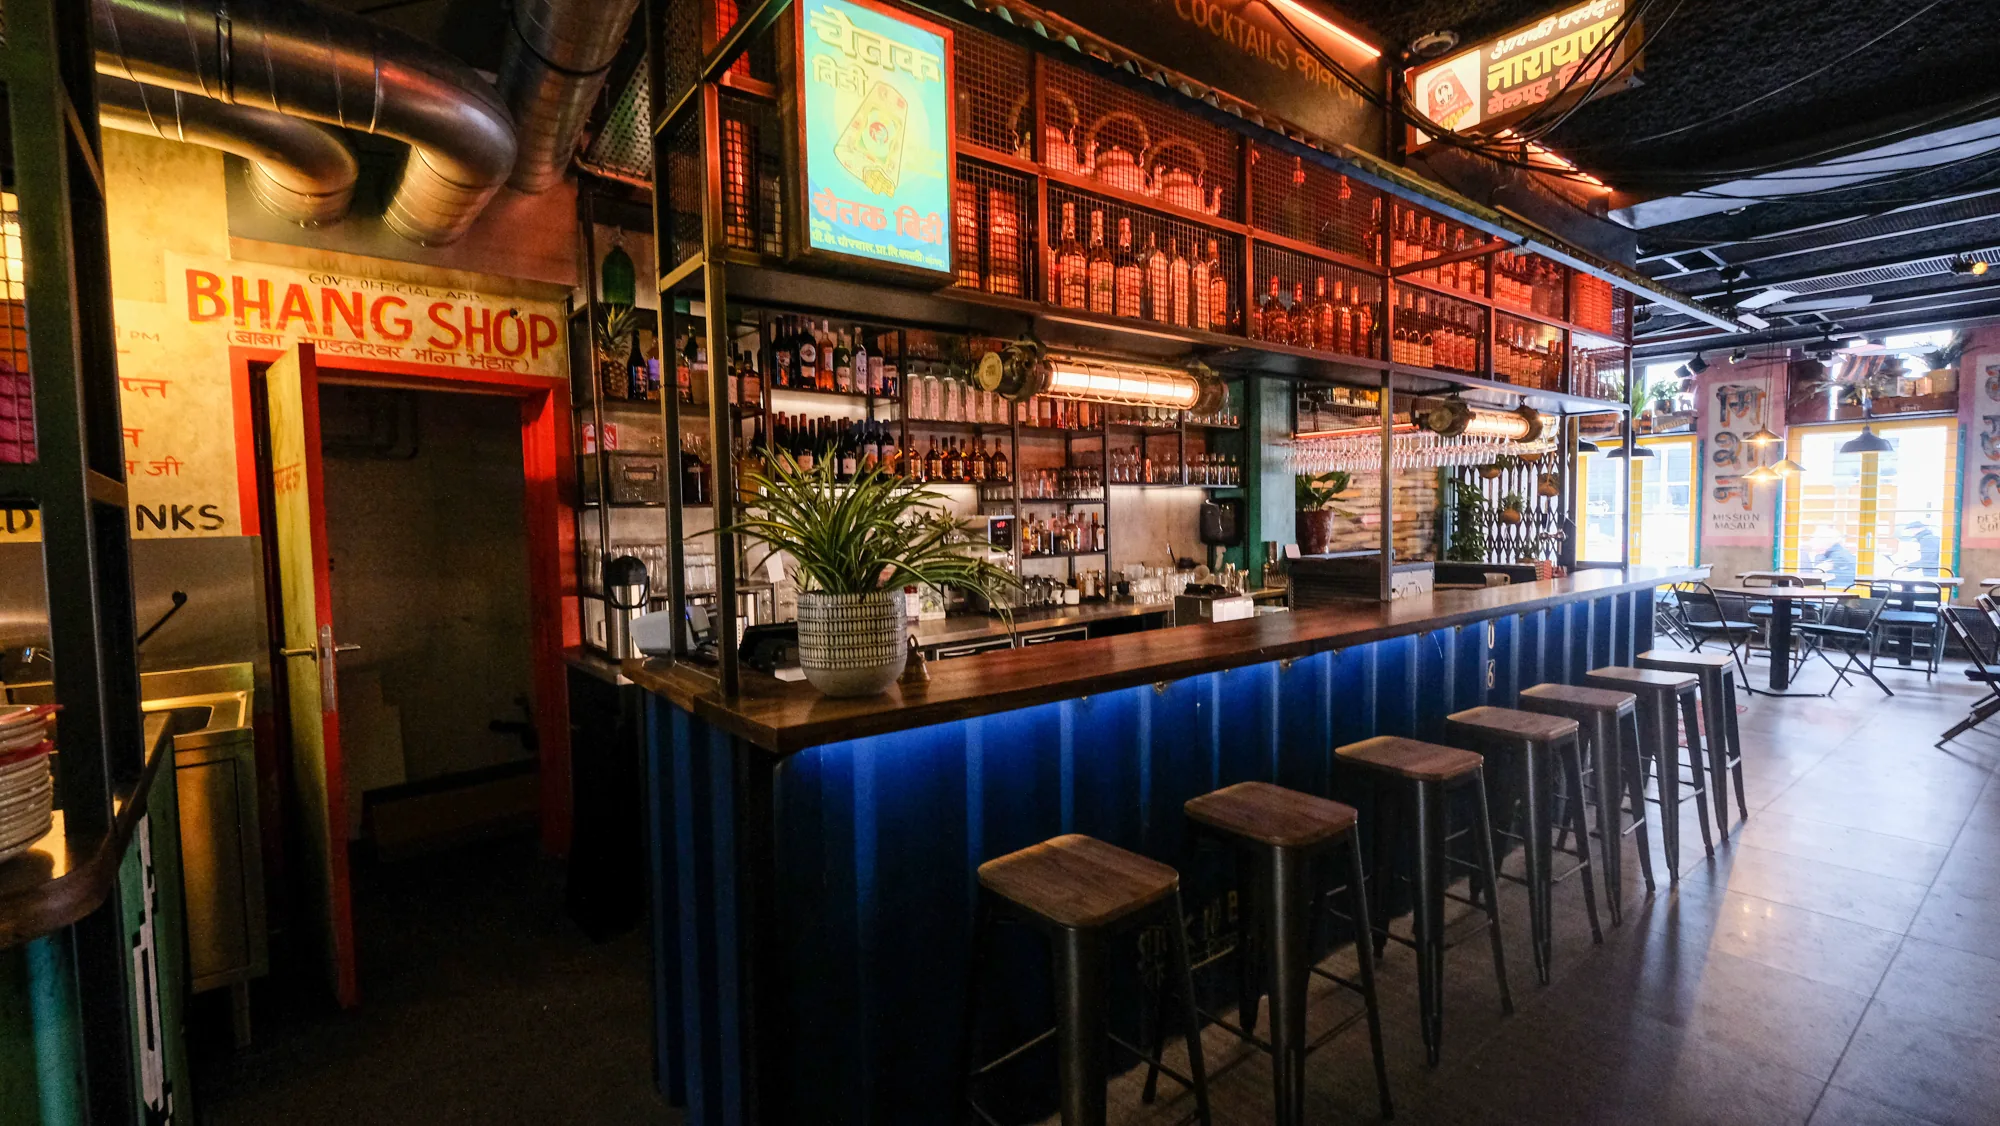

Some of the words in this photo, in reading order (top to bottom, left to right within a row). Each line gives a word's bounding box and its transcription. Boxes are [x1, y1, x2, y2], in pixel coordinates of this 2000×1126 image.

[810, 4, 942, 83] चेतक
[1175, 0, 1290, 71] COCKTAILS
[1487, 15, 1619, 91] नारायण
[811, 53, 868, 97] बिडी
[813, 187, 888, 231] चेतक
[893, 205, 944, 245] बिडी
[185, 269, 413, 343] BHANG
[427, 302, 558, 360] SHOP
[135, 503, 225, 532] NKS
[1713, 512, 1760, 522] MISSION
[1714, 521, 1755, 531] MASALA
